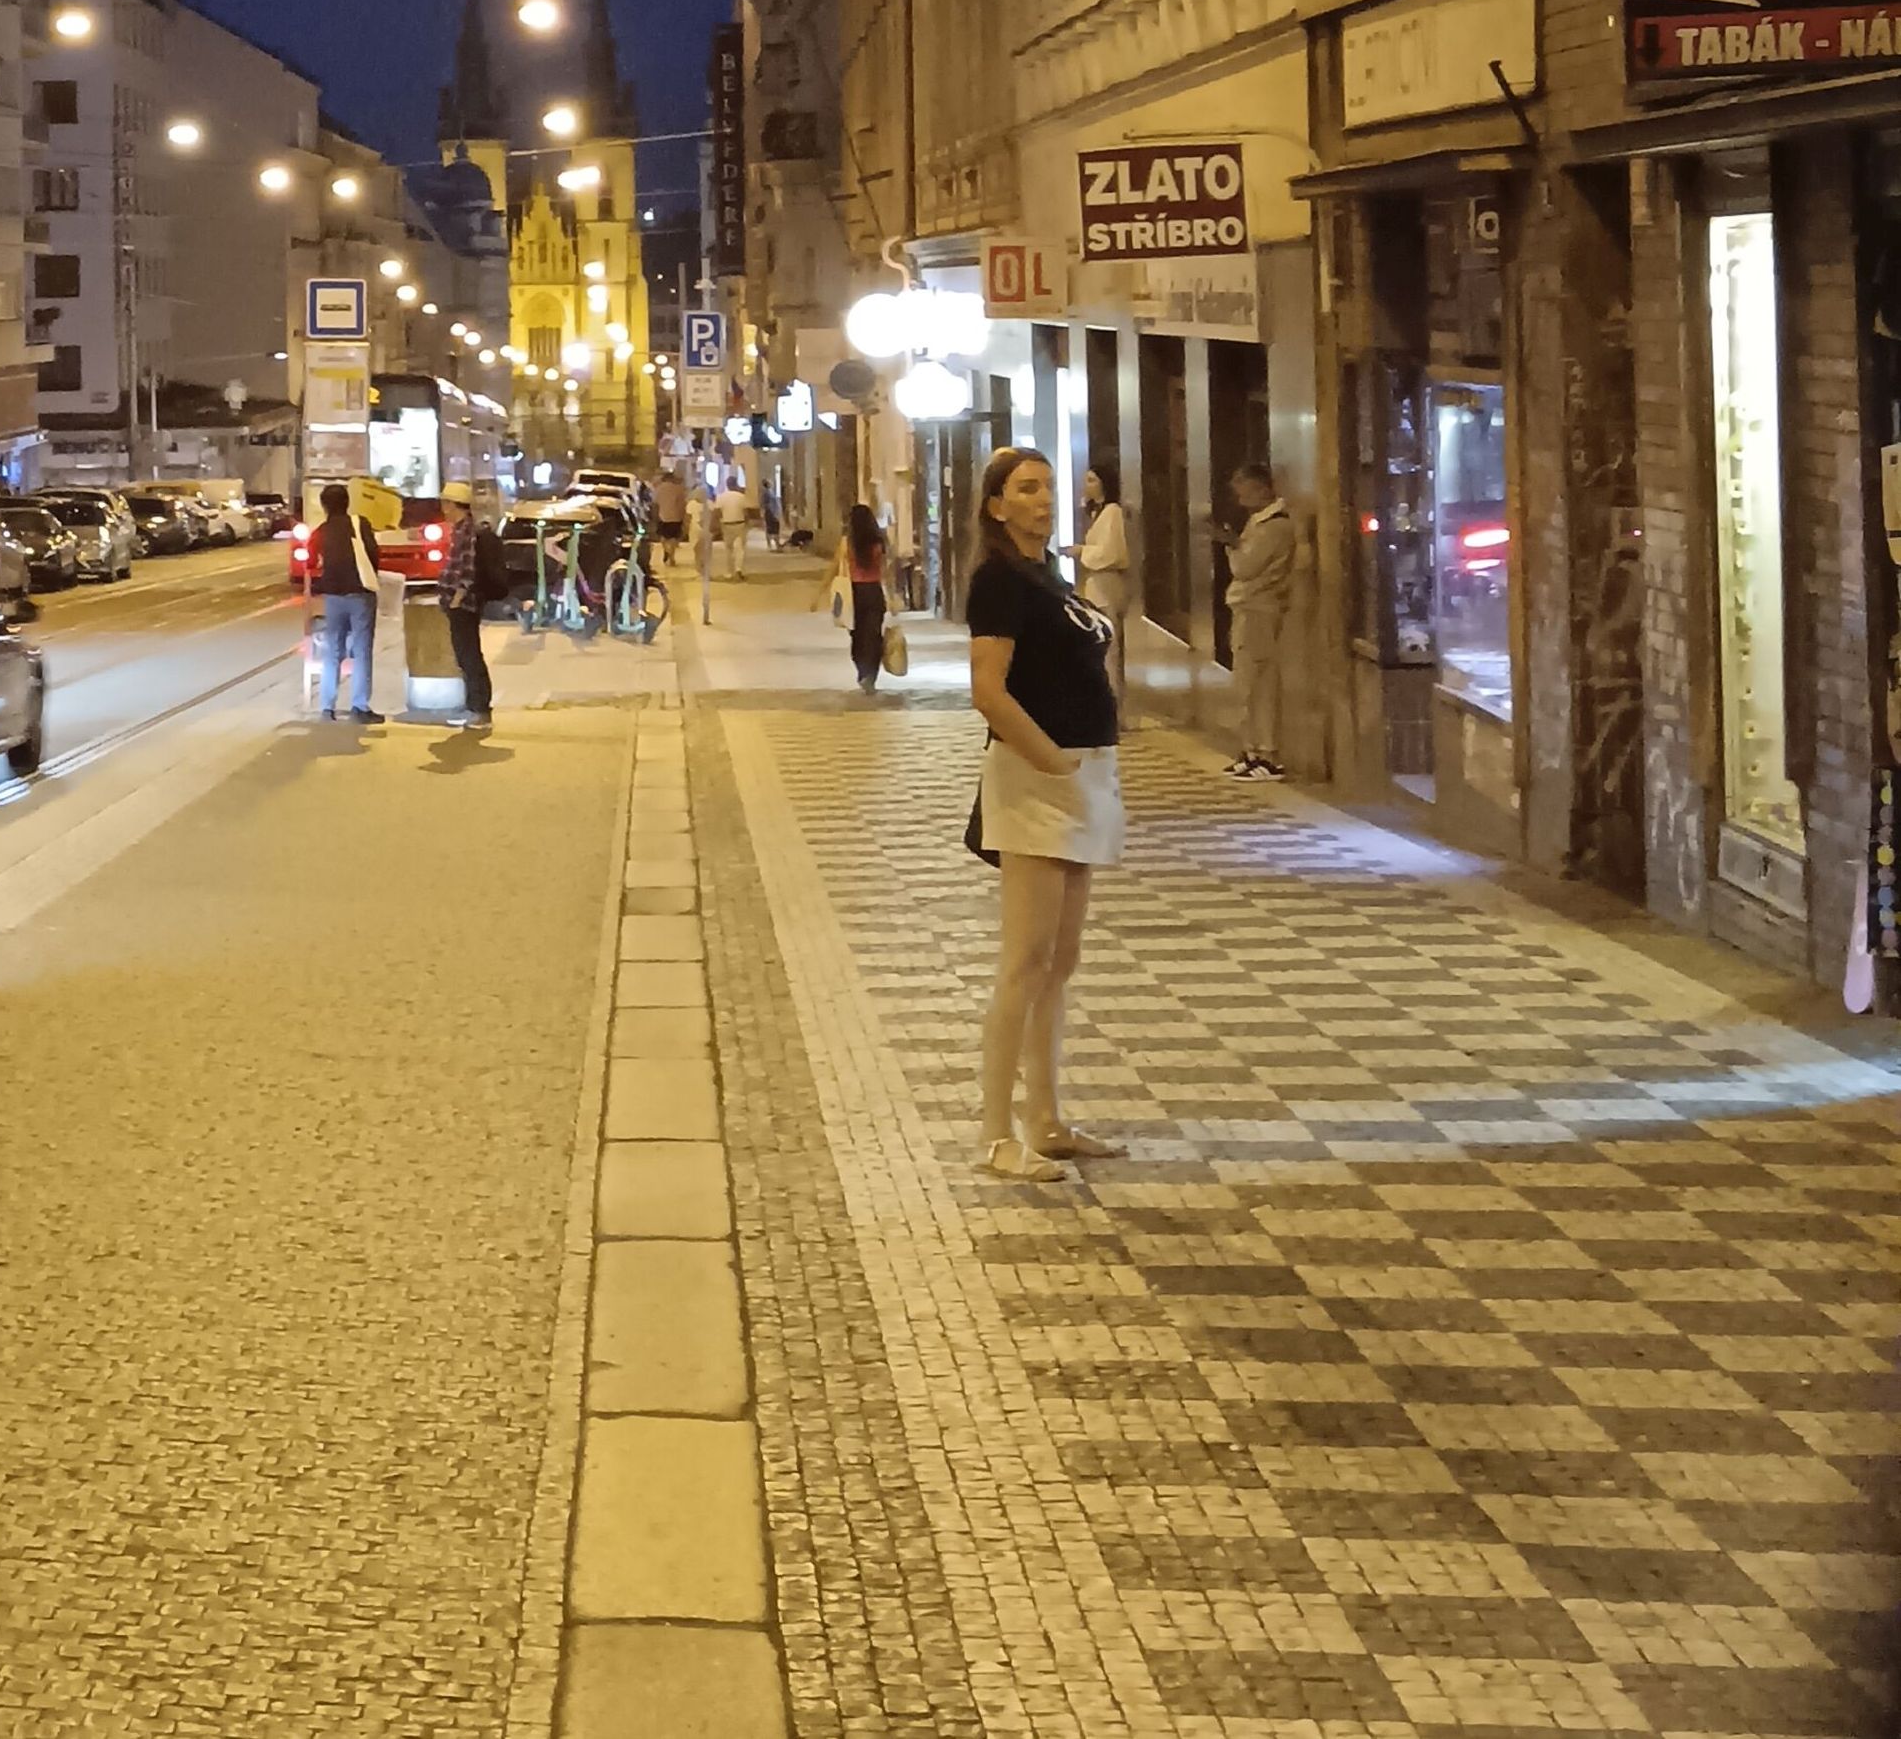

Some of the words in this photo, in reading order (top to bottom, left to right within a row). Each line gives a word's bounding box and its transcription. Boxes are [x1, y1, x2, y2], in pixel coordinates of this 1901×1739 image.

[1676, 16, 1805, 66] TABÁK
[1840, 11, 1901, 58] NÁ
[1084, 154, 1241, 206] ZLATO
[1088, 213, 1244, 252] STŘÍBRO
[692, 318, 714, 352] P
